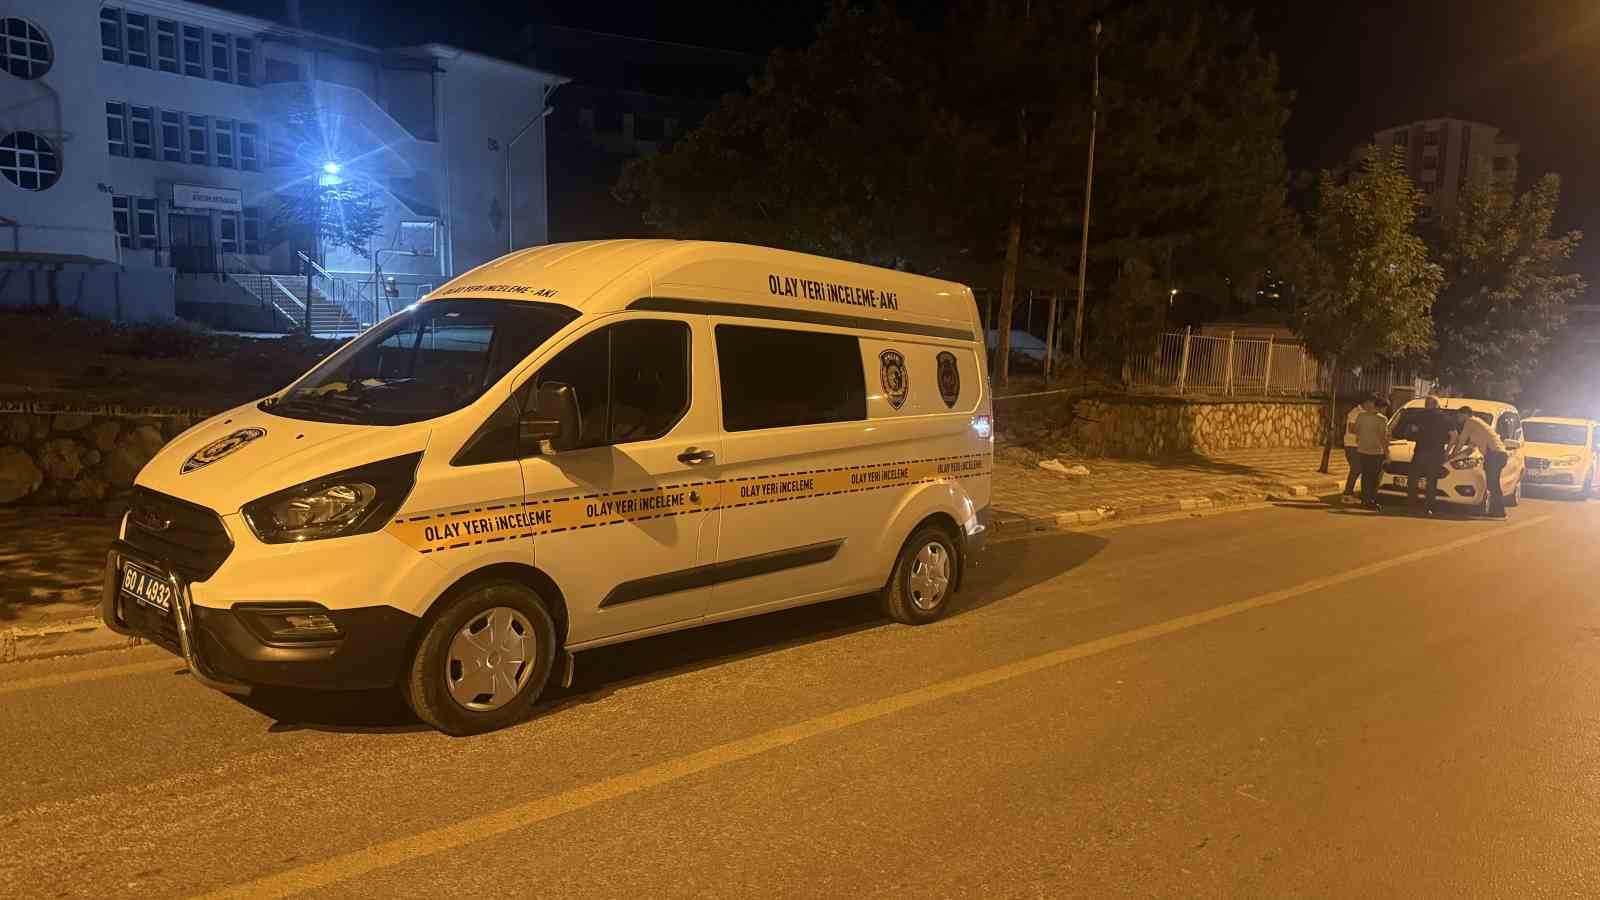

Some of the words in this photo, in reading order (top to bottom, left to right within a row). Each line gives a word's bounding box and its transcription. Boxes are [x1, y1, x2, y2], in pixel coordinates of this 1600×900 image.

[769, 274, 798, 297] OLAY
[851, 472, 866, 485] OLAY
[740, 482, 761, 498] OLAY
[587, 501, 613, 518] OLAY
[425, 522, 460, 542] OLAY
[124, 569, 137, 591] 60
[136, 575, 145, 595] A
[145, 578, 171, 608] 4932
